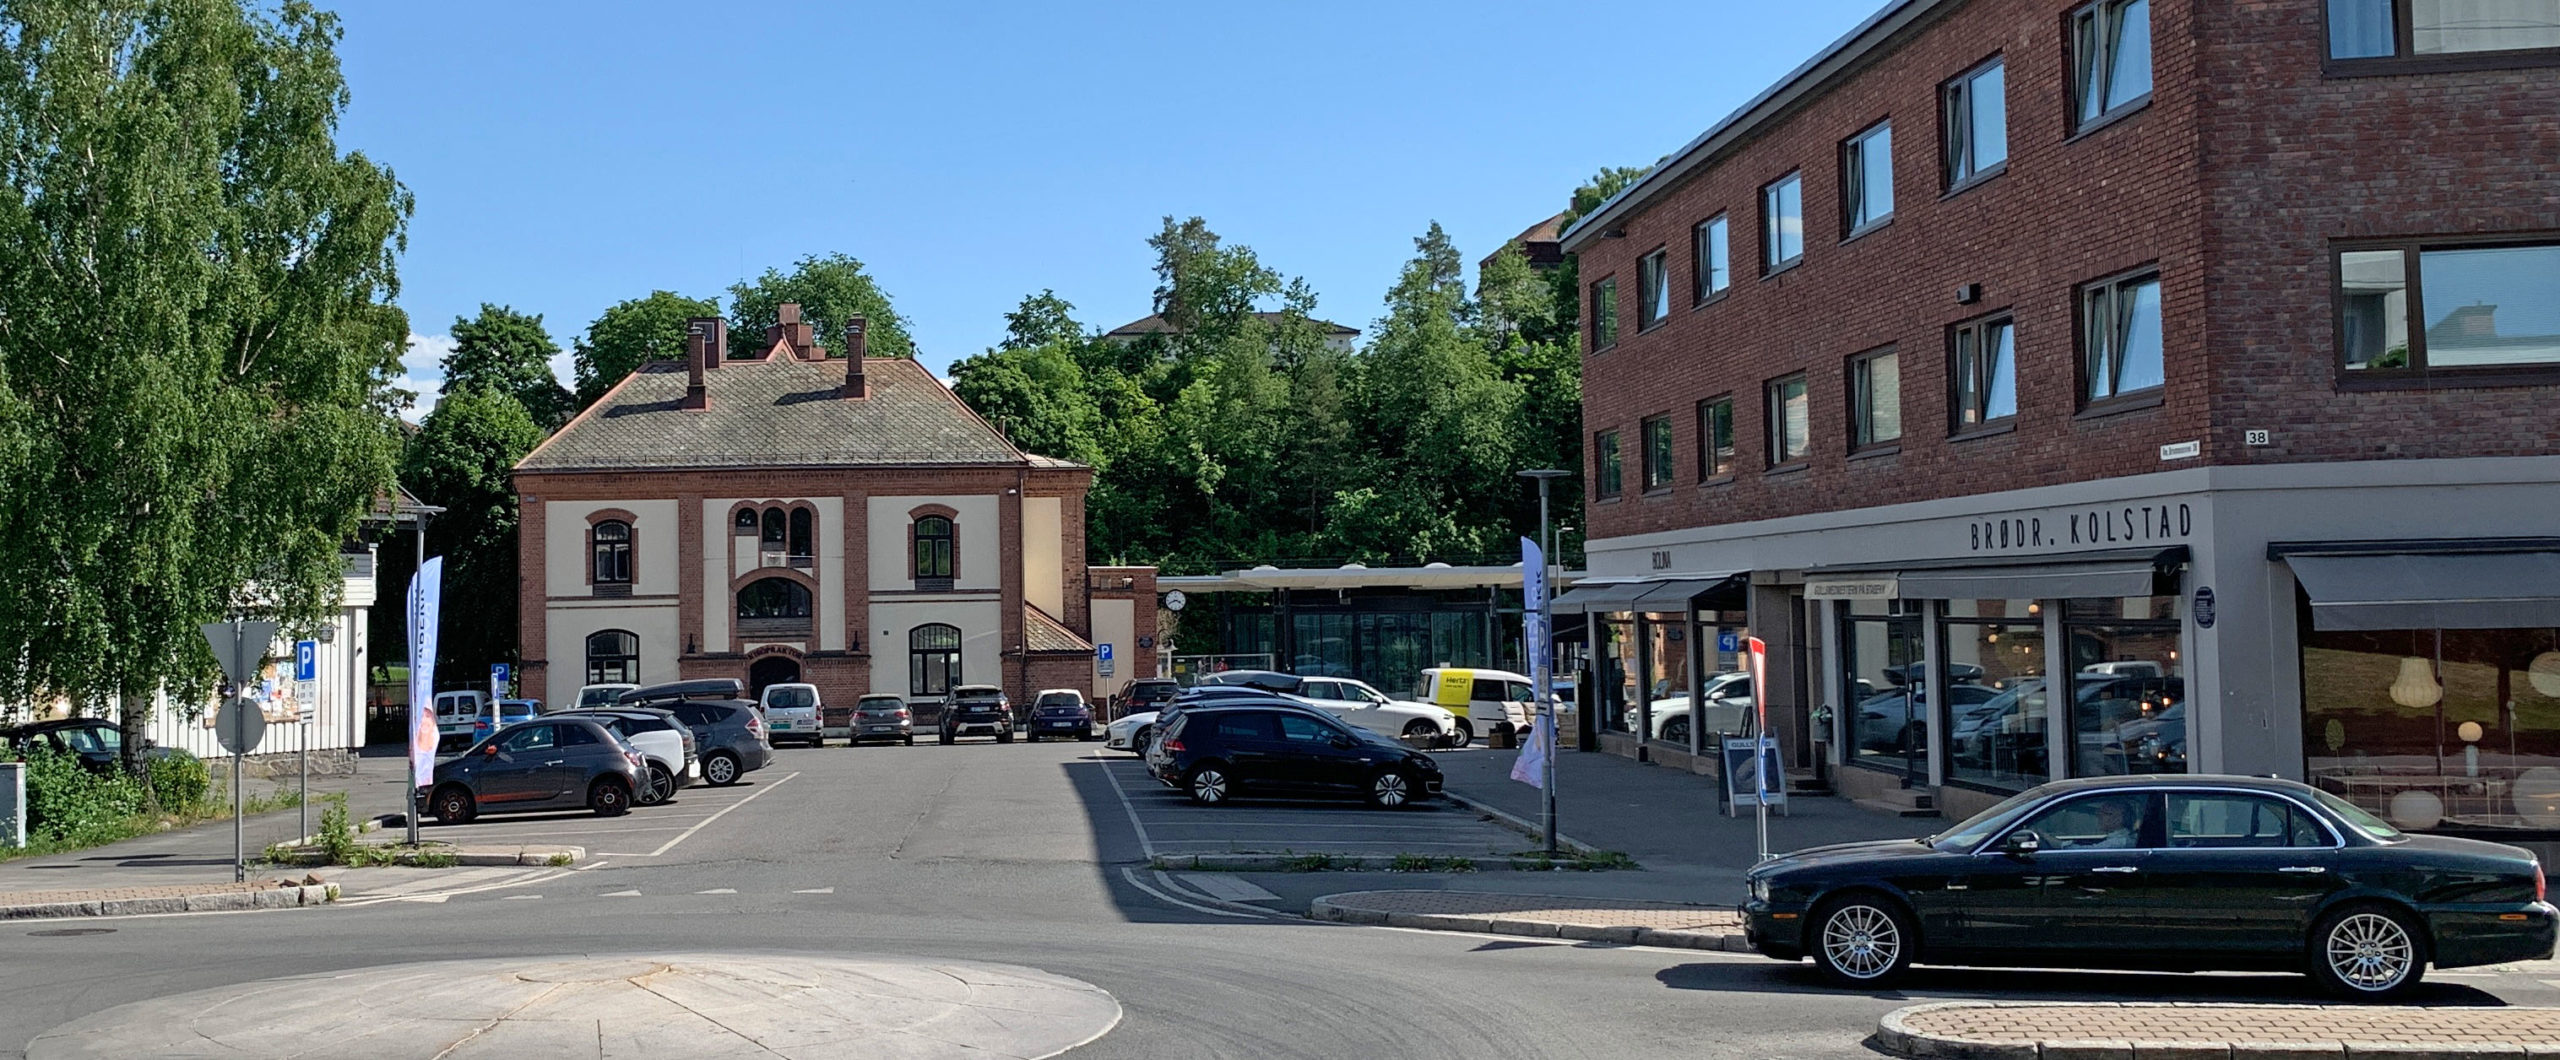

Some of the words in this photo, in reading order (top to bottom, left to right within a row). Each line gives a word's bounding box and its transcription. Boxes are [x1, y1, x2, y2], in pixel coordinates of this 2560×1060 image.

[2249, 432, 2266, 443] 38
[1971, 518, 2054, 550] BRØDR.
[2070, 503, 2191, 544] KOLSTAD
[302, 646, 311, 675] P
[1101, 645, 1110, 658] P
